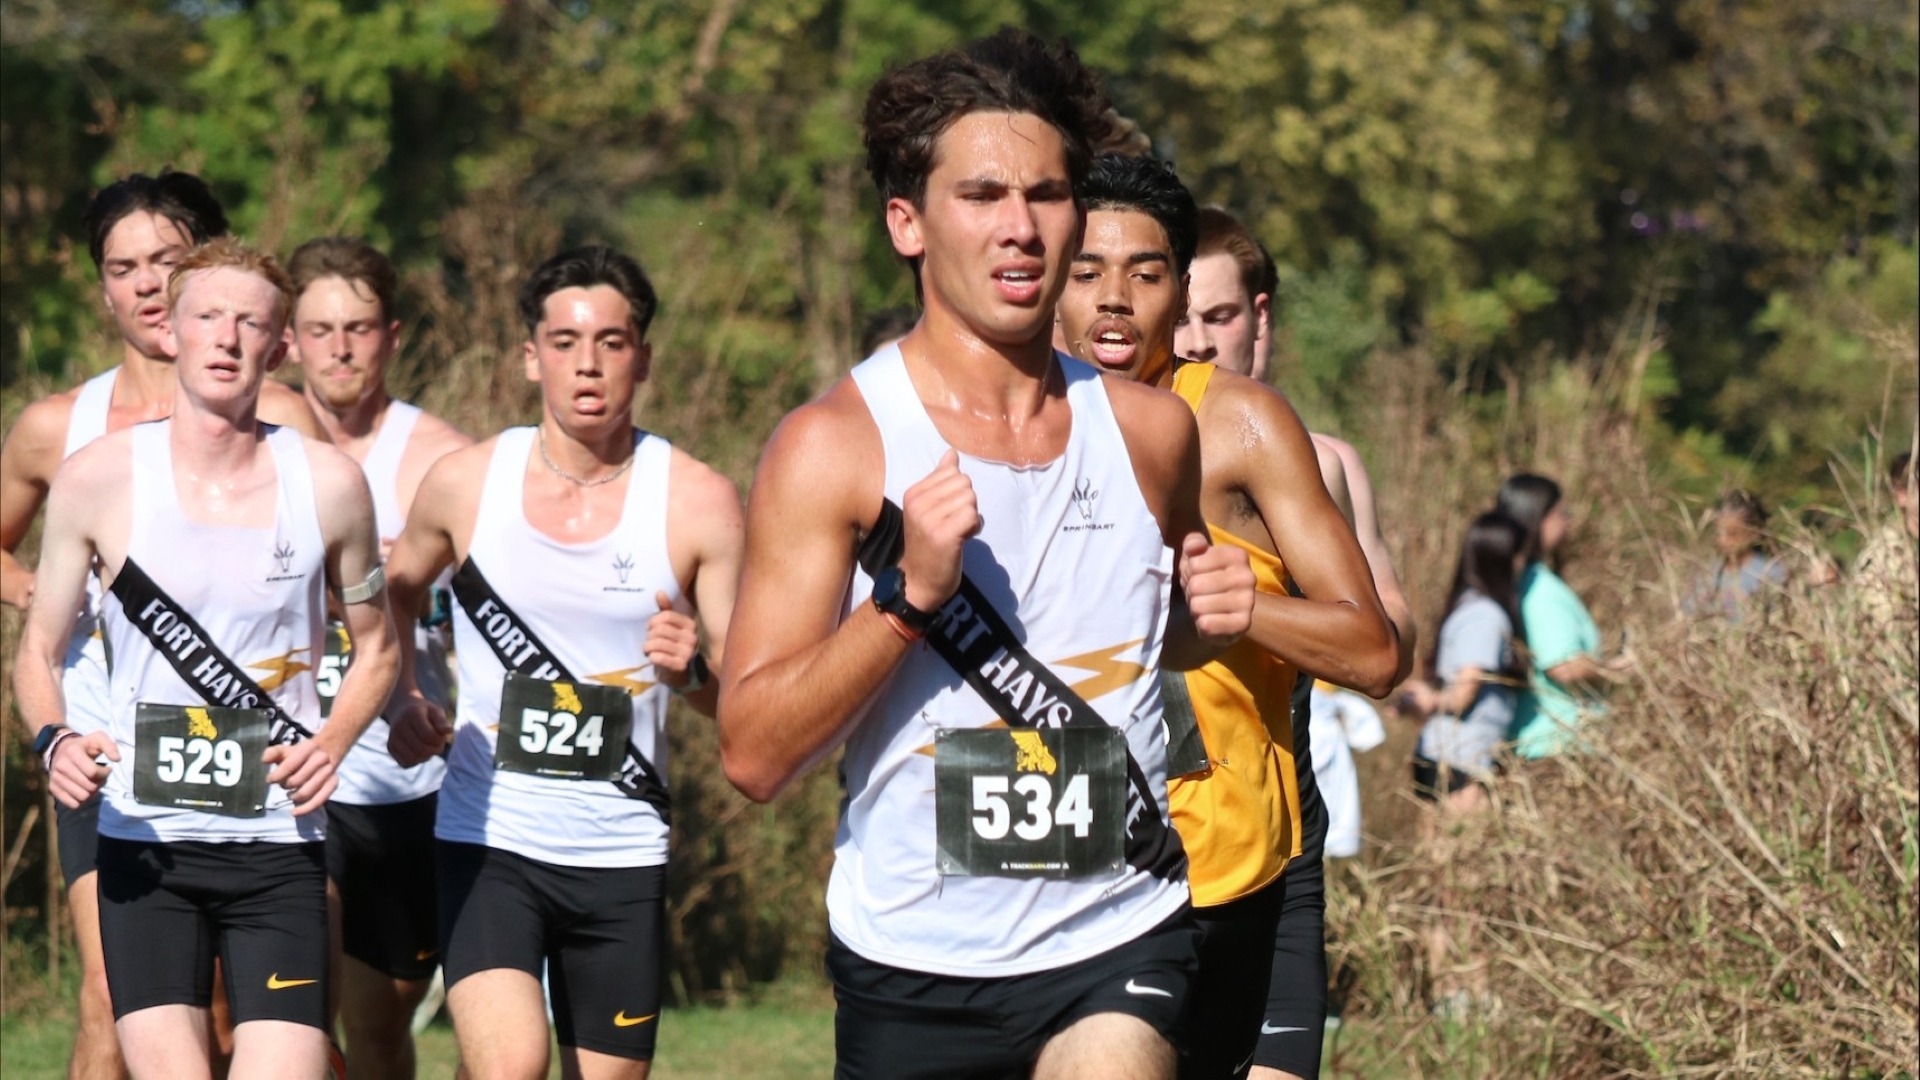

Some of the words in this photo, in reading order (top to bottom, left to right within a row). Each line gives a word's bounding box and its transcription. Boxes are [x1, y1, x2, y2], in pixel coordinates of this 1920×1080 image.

[140, 598, 206, 661] FORT
[475, 598, 541, 667] FORT
[979, 645, 1073, 729] HAYS
[157, 736, 243, 787] 529
[519, 708, 604, 756] 524
[972, 773, 1094, 841] 534
